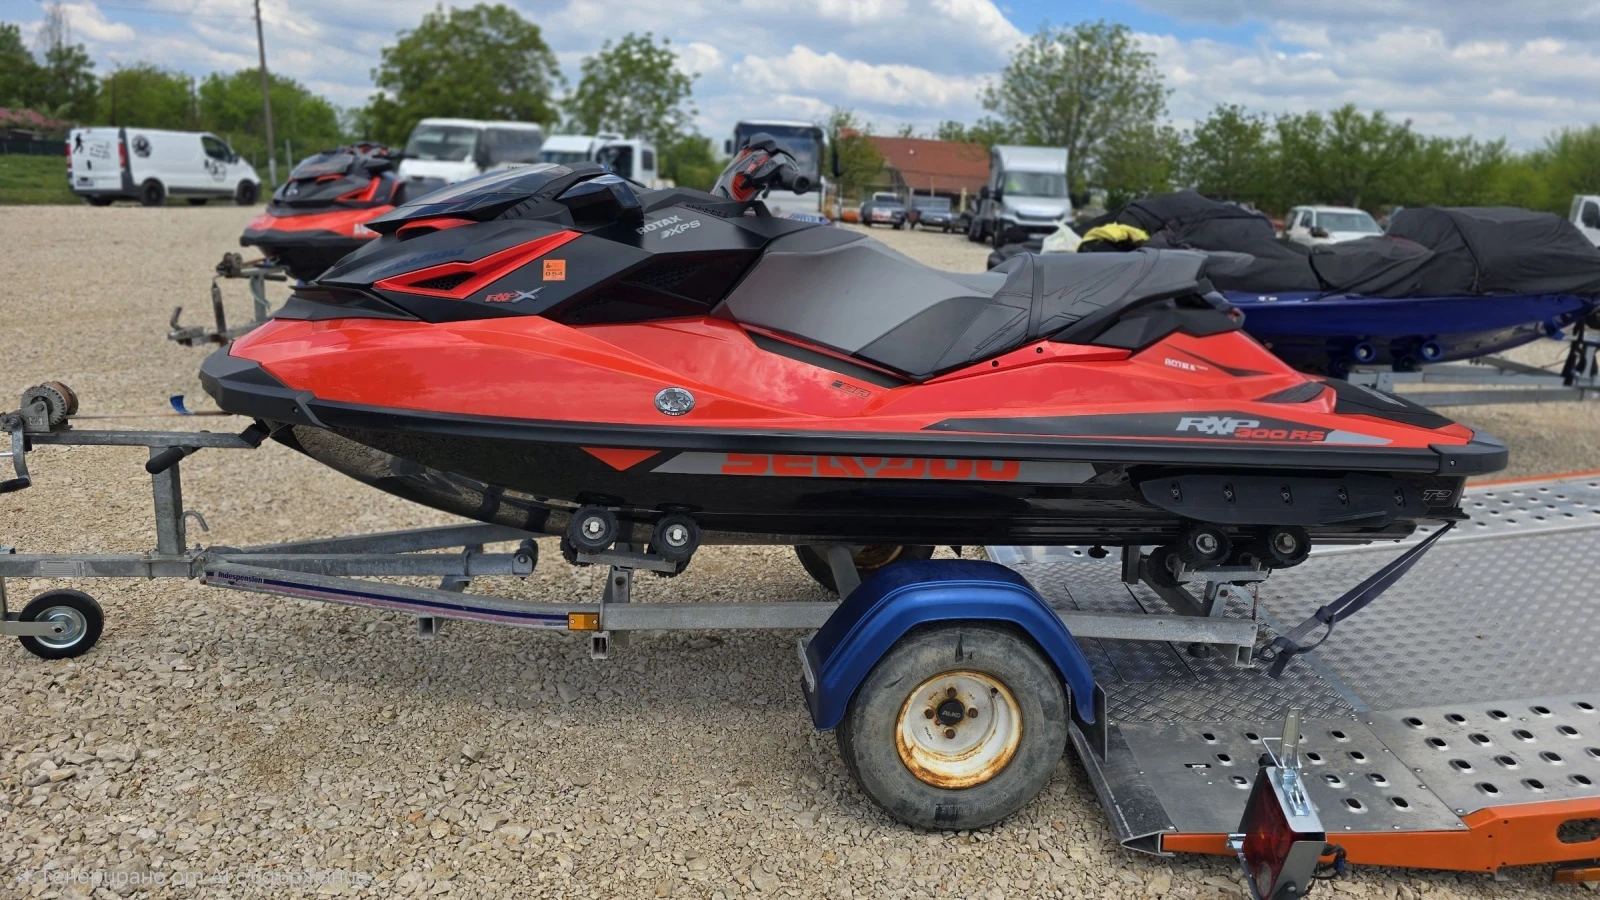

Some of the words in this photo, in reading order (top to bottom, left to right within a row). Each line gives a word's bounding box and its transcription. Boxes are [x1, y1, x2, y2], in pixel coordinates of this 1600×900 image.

[635, 214, 683, 235] ROTAX
[1175, 416, 1260, 435] RXP
[1234, 428, 1287, 440] 300
[1289, 429, 1325, 441] RS
[218, 571, 263, 584] Indespension
